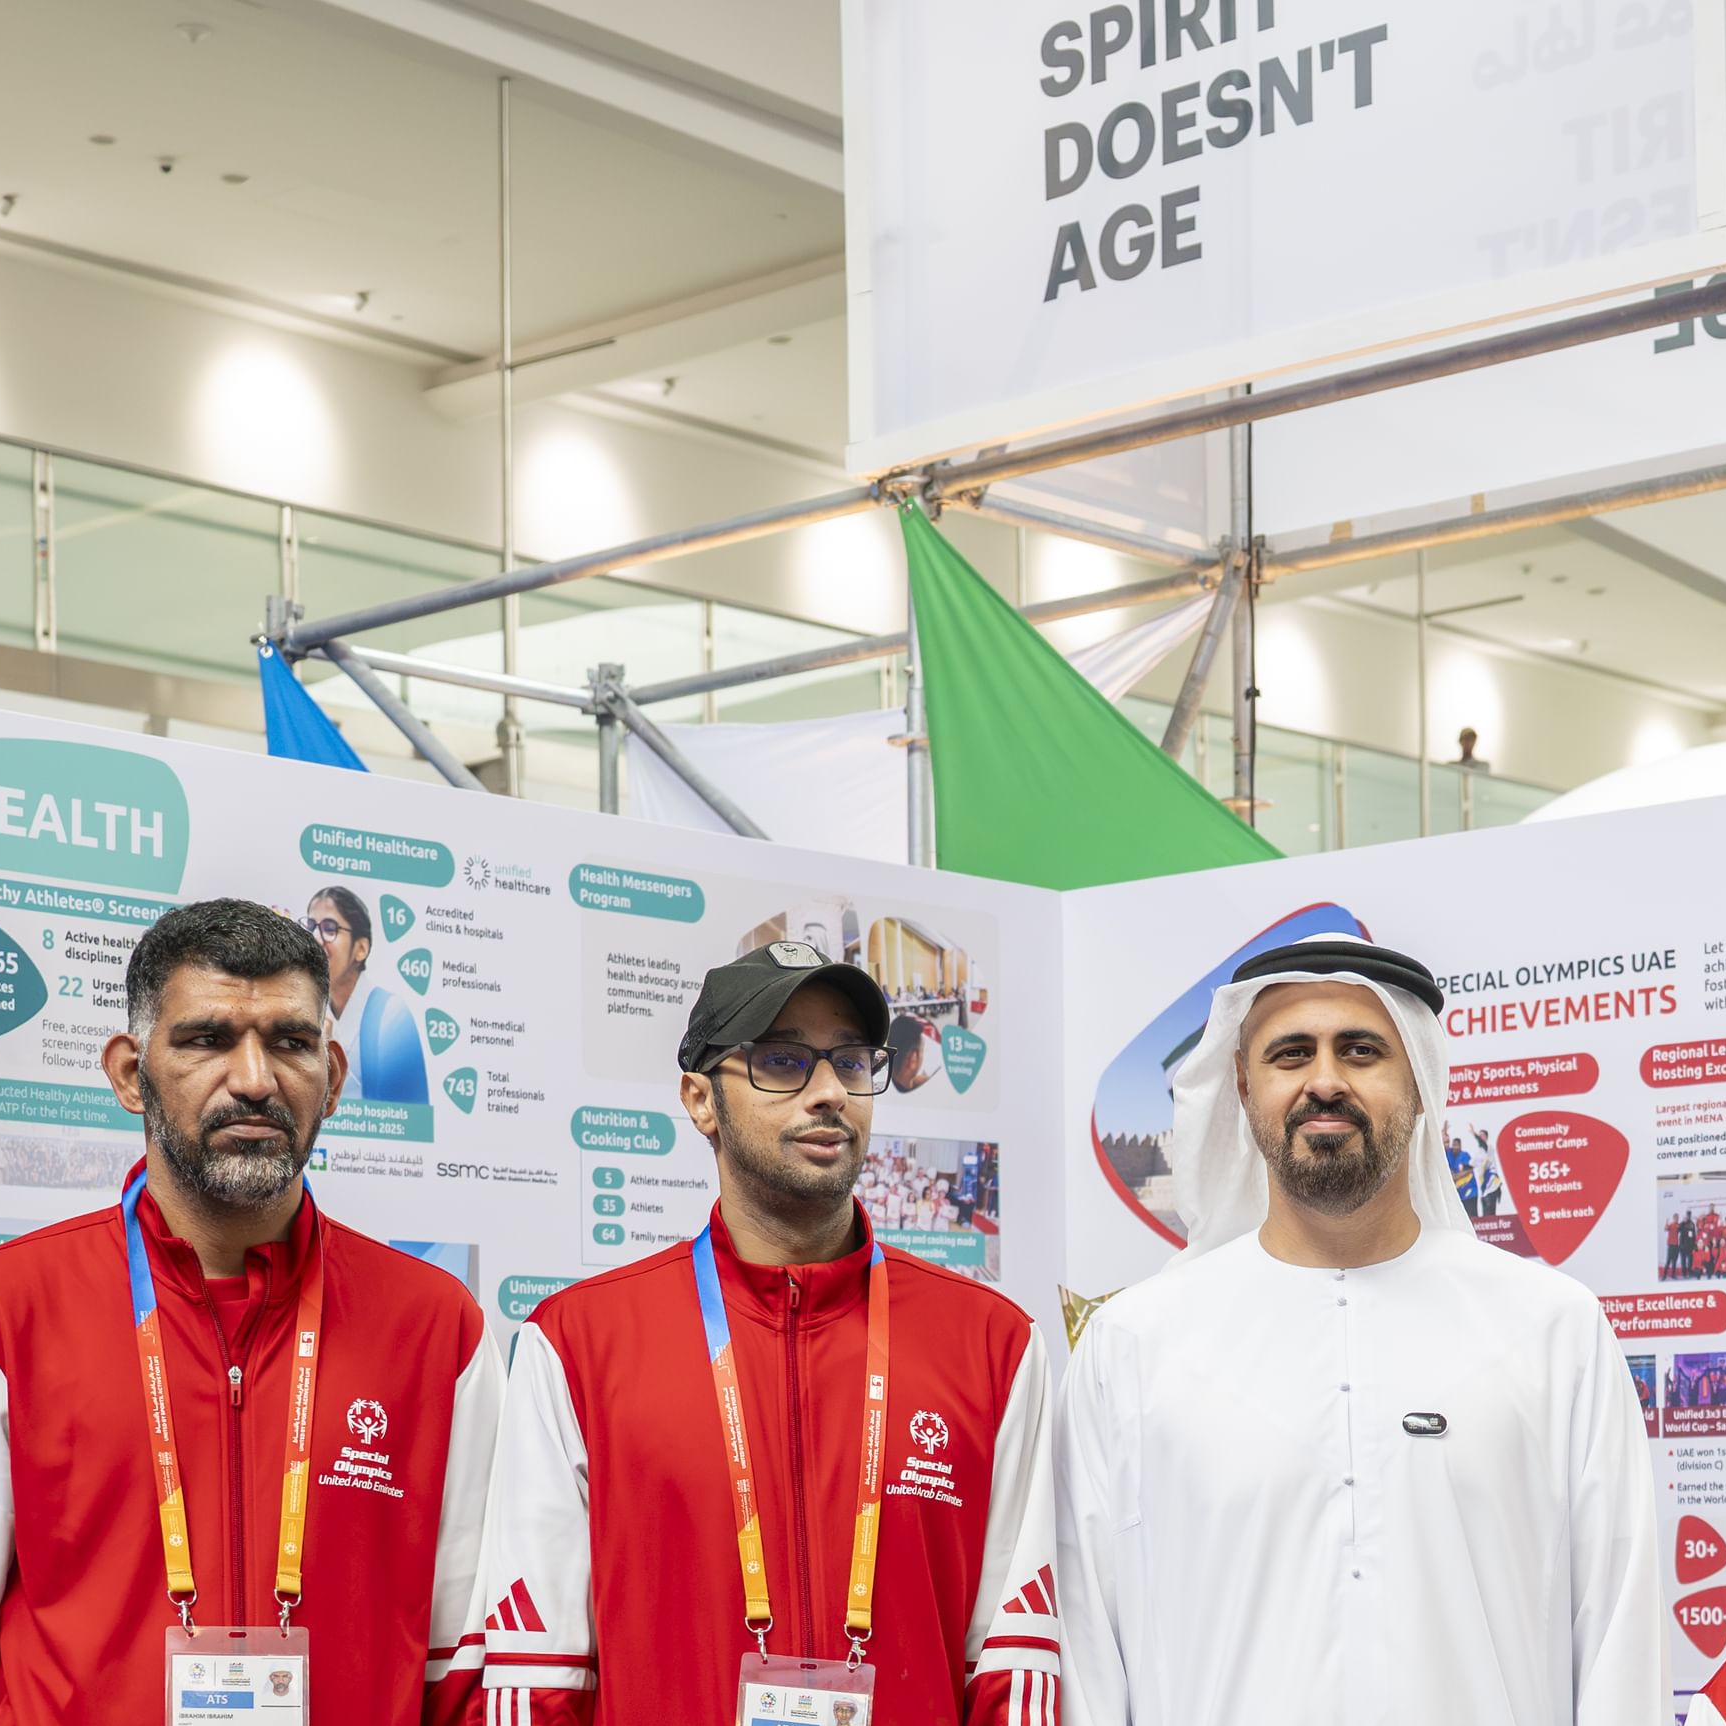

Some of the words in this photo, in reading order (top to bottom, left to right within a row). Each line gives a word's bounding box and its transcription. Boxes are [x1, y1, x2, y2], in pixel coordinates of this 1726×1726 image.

[1044, 24, 1387, 201] DOESN'T
[1043, 184, 1202, 303] AGE
[313, 829, 362, 850] Unified
[365, 837, 438, 861] Healthcare
[312, 850, 371, 872] Program
[494, 864, 532, 879] unified
[495, 877, 551, 895] healthcare
[580, 868, 619, 886] Health
[623, 875, 692, 897] Messengers
[580, 889, 631, 908] Program
[386, 907, 406, 925] 16
[425, 906, 474, 921] Accredited
[65, 948, 122, 964] disciplines
[1704, 941, 1723, 955] Let
[401, 959, 429, 977] 460
[442, 961, 477, 973] Medical
[1437, 970, 1509, 995] PECIAL
[1516, 955, 1623, 986] OLYMPICS
[1632, 949, 1676, 973] UAE
[442, 977, 501, 992] professionals
[1447, 984, 1677, 1038] CHIEVEMENTS
[429, 1020, 456, 1039] 283
[471, 1034, 514, 1047] personnel
[1653, 1043, 1708, 1064] Regional
[487, 1072, 510, 1082] Total
[1483, 1064, 1526, 1080] Sports,
[1528, 1057, 1577, 1075] Physical
[1653, 1062, 1703, 1081] Hosting
[447, 1078, 474, 1096] 743
[1463, 1087, 1472, 1099] &
[1475, 1082, 1539, 1099] Awareness
[582, 1111, 637, 1129] Nutrition
[639, 1116, 649, 1129] &
[1515, 1124, 1570, 1138] Community
[582, 1131, 631, 1150] Cooking
[634, 1137, 660, 1149] Club
[1515, 1140, 1554, 1152] Summer
[1556, 1137, 1588, 1150] Camps
[436, 1162, 489, 1180] ssmc
[1529, 1161, 1570, 1181] 365+
[1529, 1181, 1582, 1194] Participants
[1637, 1298, 1704, 1313] Excellence
[1706, 1295, 1716, 1308] &
[1611, 1316, 1693, 1331] Performance
[1673, 1409, 1704, 1420] Unified
[1706, 1409, 1721, 1418] 3x3
[340, 1446, 389, 1466] Special
[333, 1460, 393, 1481] Olympics
[906, 1456, 952, 1476] Special
[318, 1474, 351, 1488] United
[352, 1476, 373, 1491] Arab
[373, 1483, 404, 1498] Emirates
[900, 1469, 955, 1491] Olympics
[886, 1484, 917, 1497] United
[917, 1485, 935, 1500] Arab
[935, 1490, 963, 1508] Emirates
[1685, 1540, 1718, 1559] 30+
[206, 1694, 228, 1704] ATS
